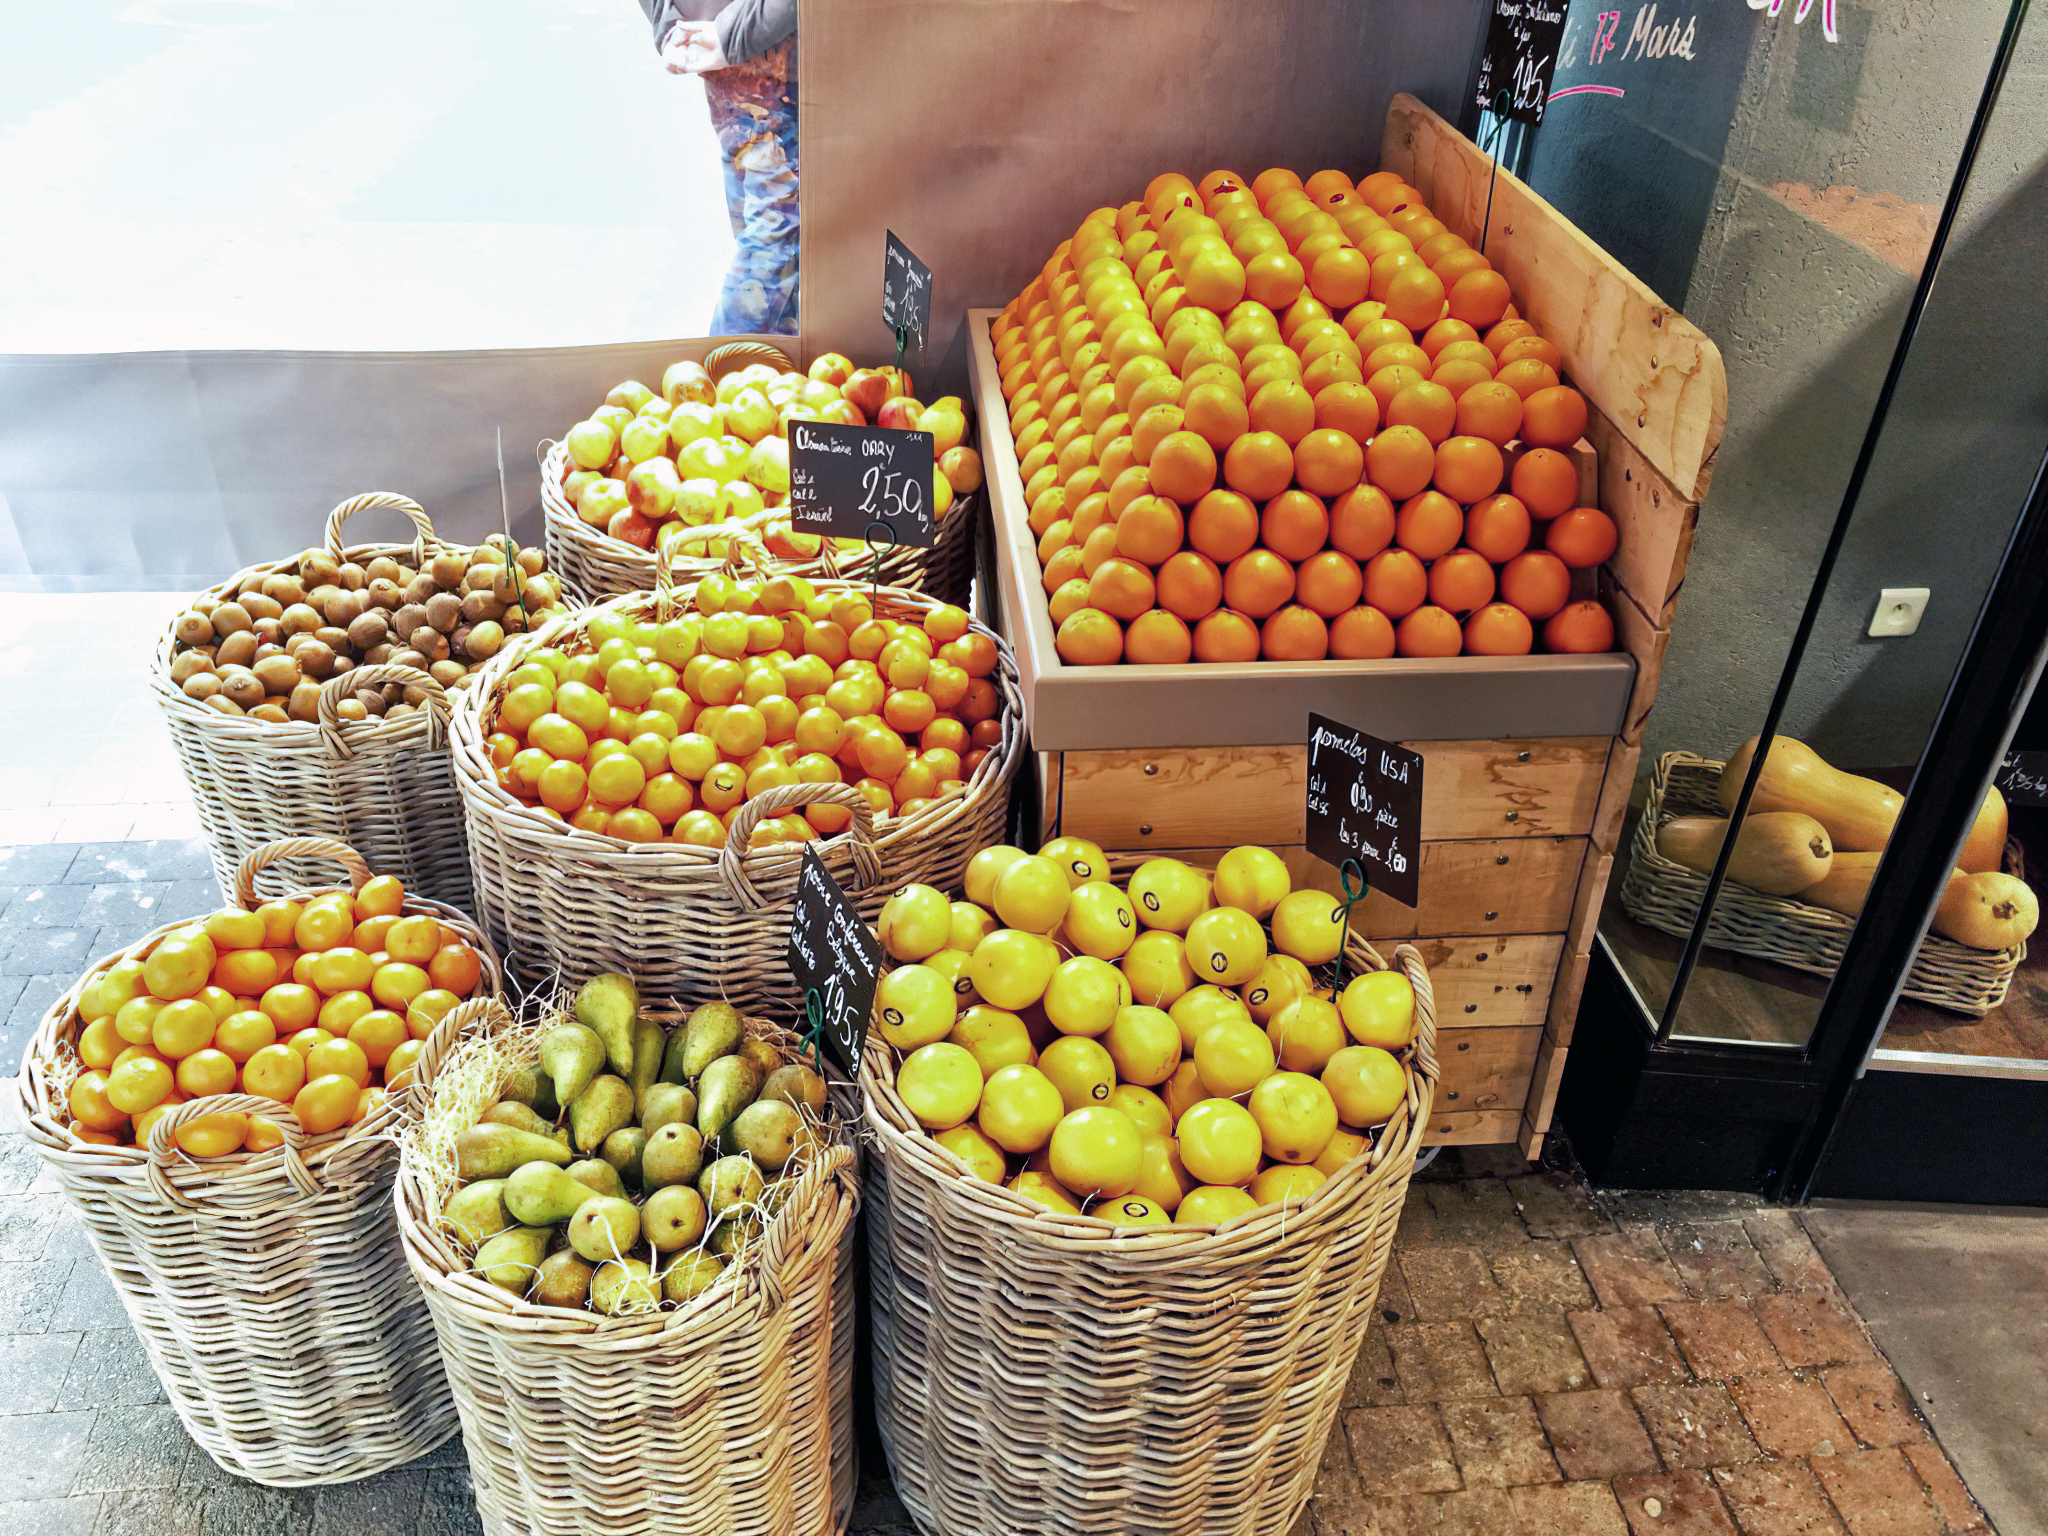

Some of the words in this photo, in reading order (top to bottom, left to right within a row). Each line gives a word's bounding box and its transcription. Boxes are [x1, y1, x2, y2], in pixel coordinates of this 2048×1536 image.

[1620, 3, 1697, 62] Mars
[1310, 726, 1368, 766] pomelos
[1380, 750, 1408, 784] USA
[1351, 832, 1359, 849] 3
